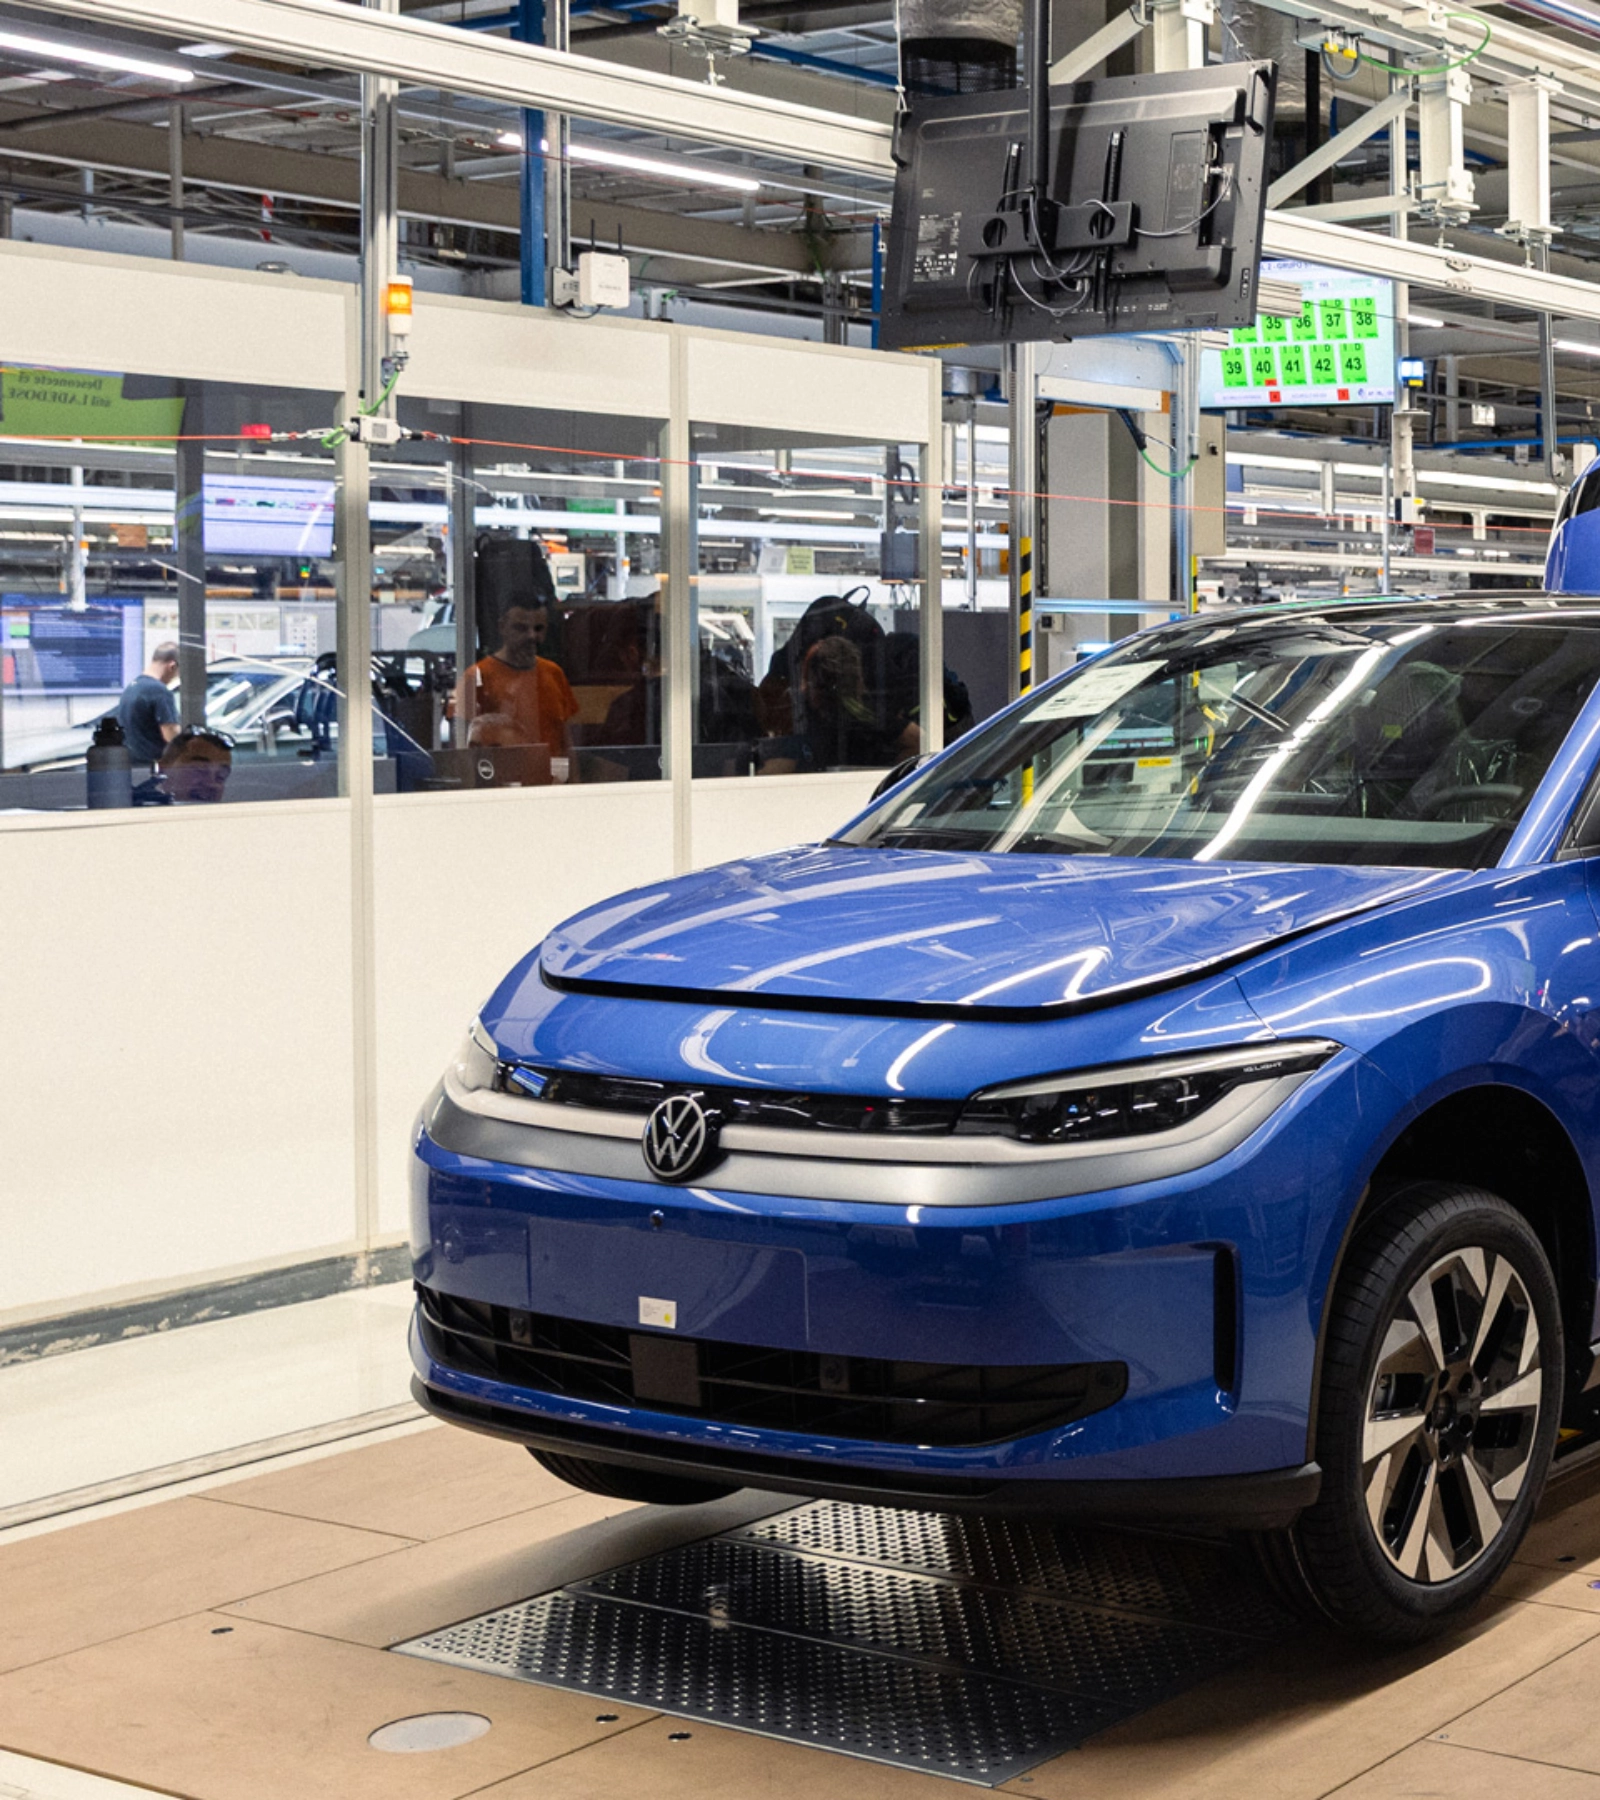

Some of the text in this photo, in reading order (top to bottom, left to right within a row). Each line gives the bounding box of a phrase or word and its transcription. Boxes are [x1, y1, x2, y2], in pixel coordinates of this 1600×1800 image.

[1265, 311, 1373, 329] 35 36 37 38
[1226, 357, 1362, 375] 39 40 41 42 43
